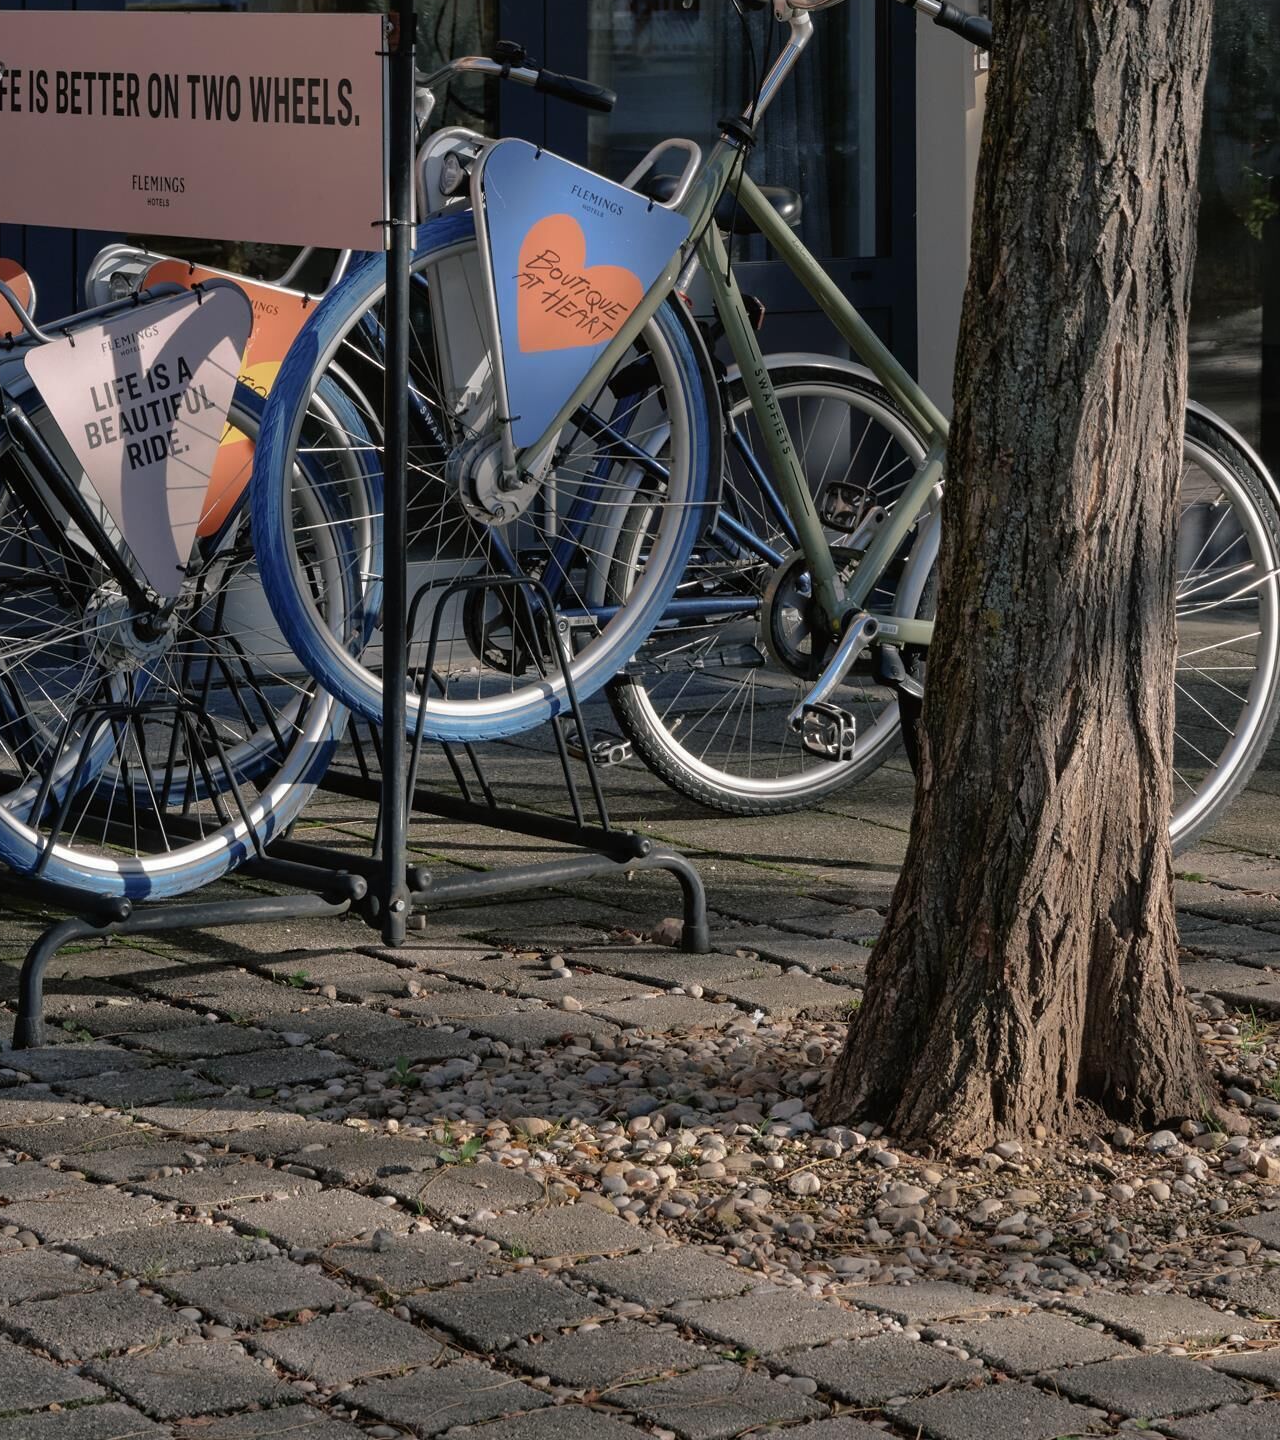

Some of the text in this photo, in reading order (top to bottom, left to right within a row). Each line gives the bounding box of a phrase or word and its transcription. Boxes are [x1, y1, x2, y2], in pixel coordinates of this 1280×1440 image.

[28, 69, 49, 114] IS
[55, 70, 141, 118] BETTER
[147, 73, 179, 119] ON
[186, 74, 242, 122] TWO
[249, 75, 361, 127] WHEELS.
[132, 174, 185, 193] FLEMINGS
[147, 198, 170, 208] HOTELS
[570, 184, 624, 217] FLEMINGS
[512, 271, 614, 340] AT HEART
[101, 325, 160, 353] FLEMINGS
[90, 356, 194, 413] LIFE IS A
[84, 384, 216, 450] BEAUTIFUL
[420, 406, 449, 455] SWAPF
[754, 368, 792, 456] SWAPFIETS
[126, 428, 190, 471] RIDE.
